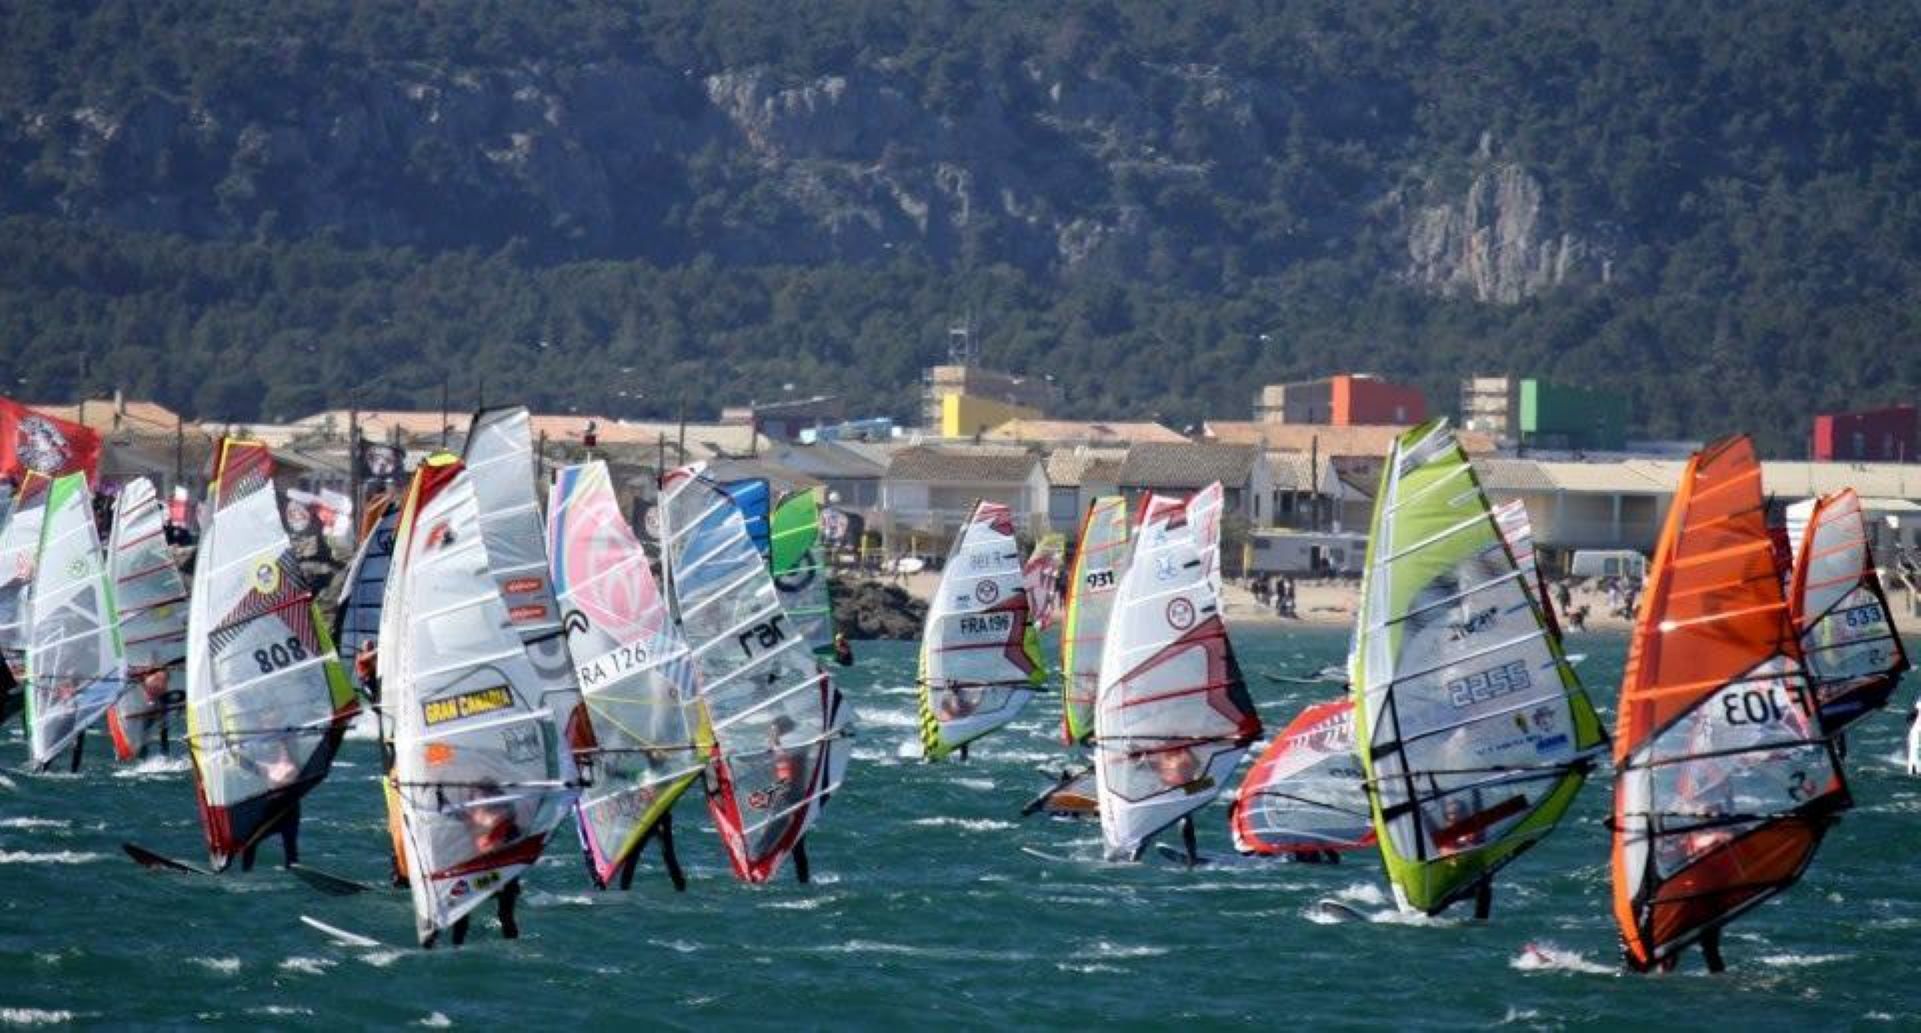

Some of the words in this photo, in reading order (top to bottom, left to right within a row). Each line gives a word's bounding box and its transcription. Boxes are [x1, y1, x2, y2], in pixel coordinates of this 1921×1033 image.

[1087, 570, 1114, 588] 931
[254, 636, 307, 673] 808
[610, 641, 647, 673] 126
[1447, 660, 1530, 707] 2255
[424, 700, 459, 724] GRAN
